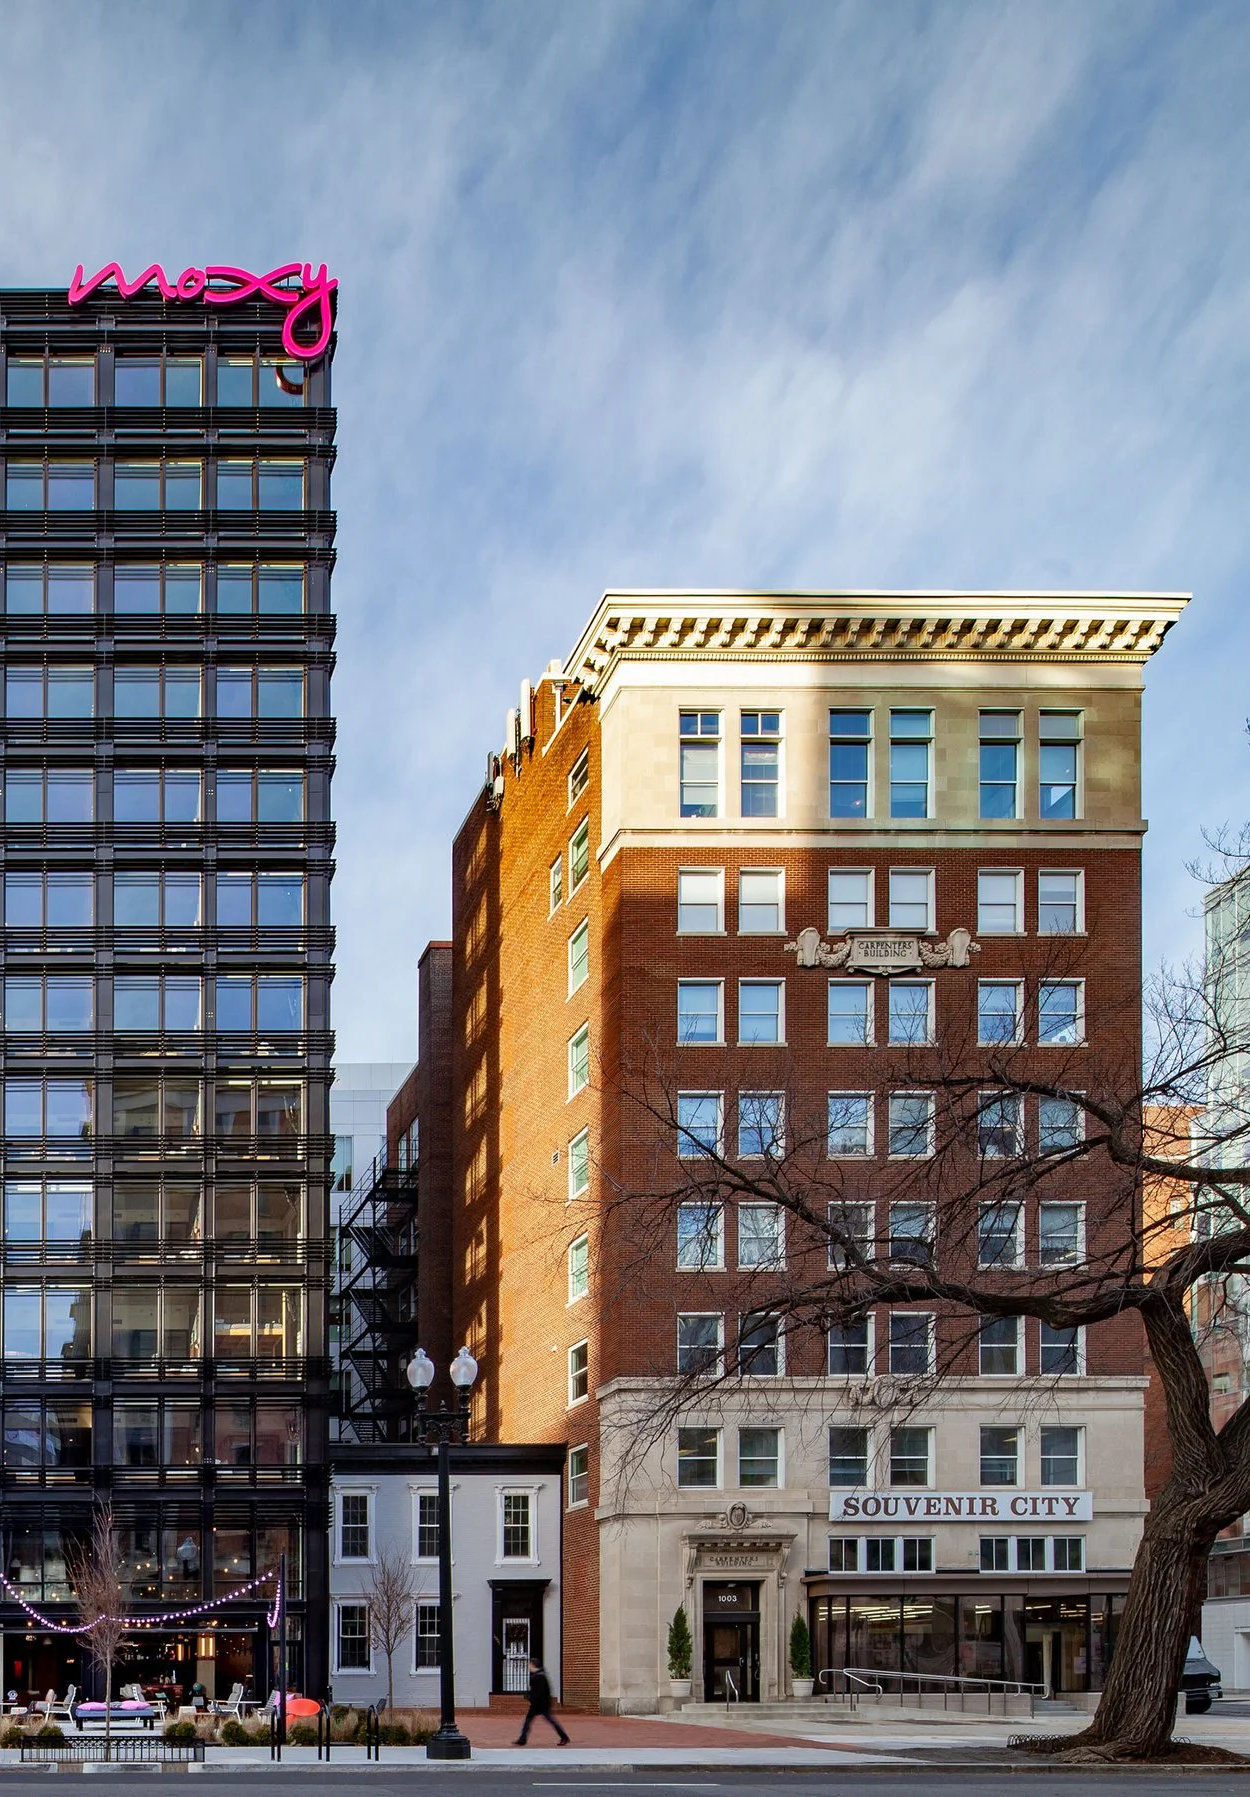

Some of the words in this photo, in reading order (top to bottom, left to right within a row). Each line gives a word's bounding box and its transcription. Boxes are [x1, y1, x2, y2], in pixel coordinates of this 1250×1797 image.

[68, 262, 339, 360] moxy
[843, 1496, 1000, 1517] SOUVENIR
[1010, 1496, 1081, 1517] CITY
